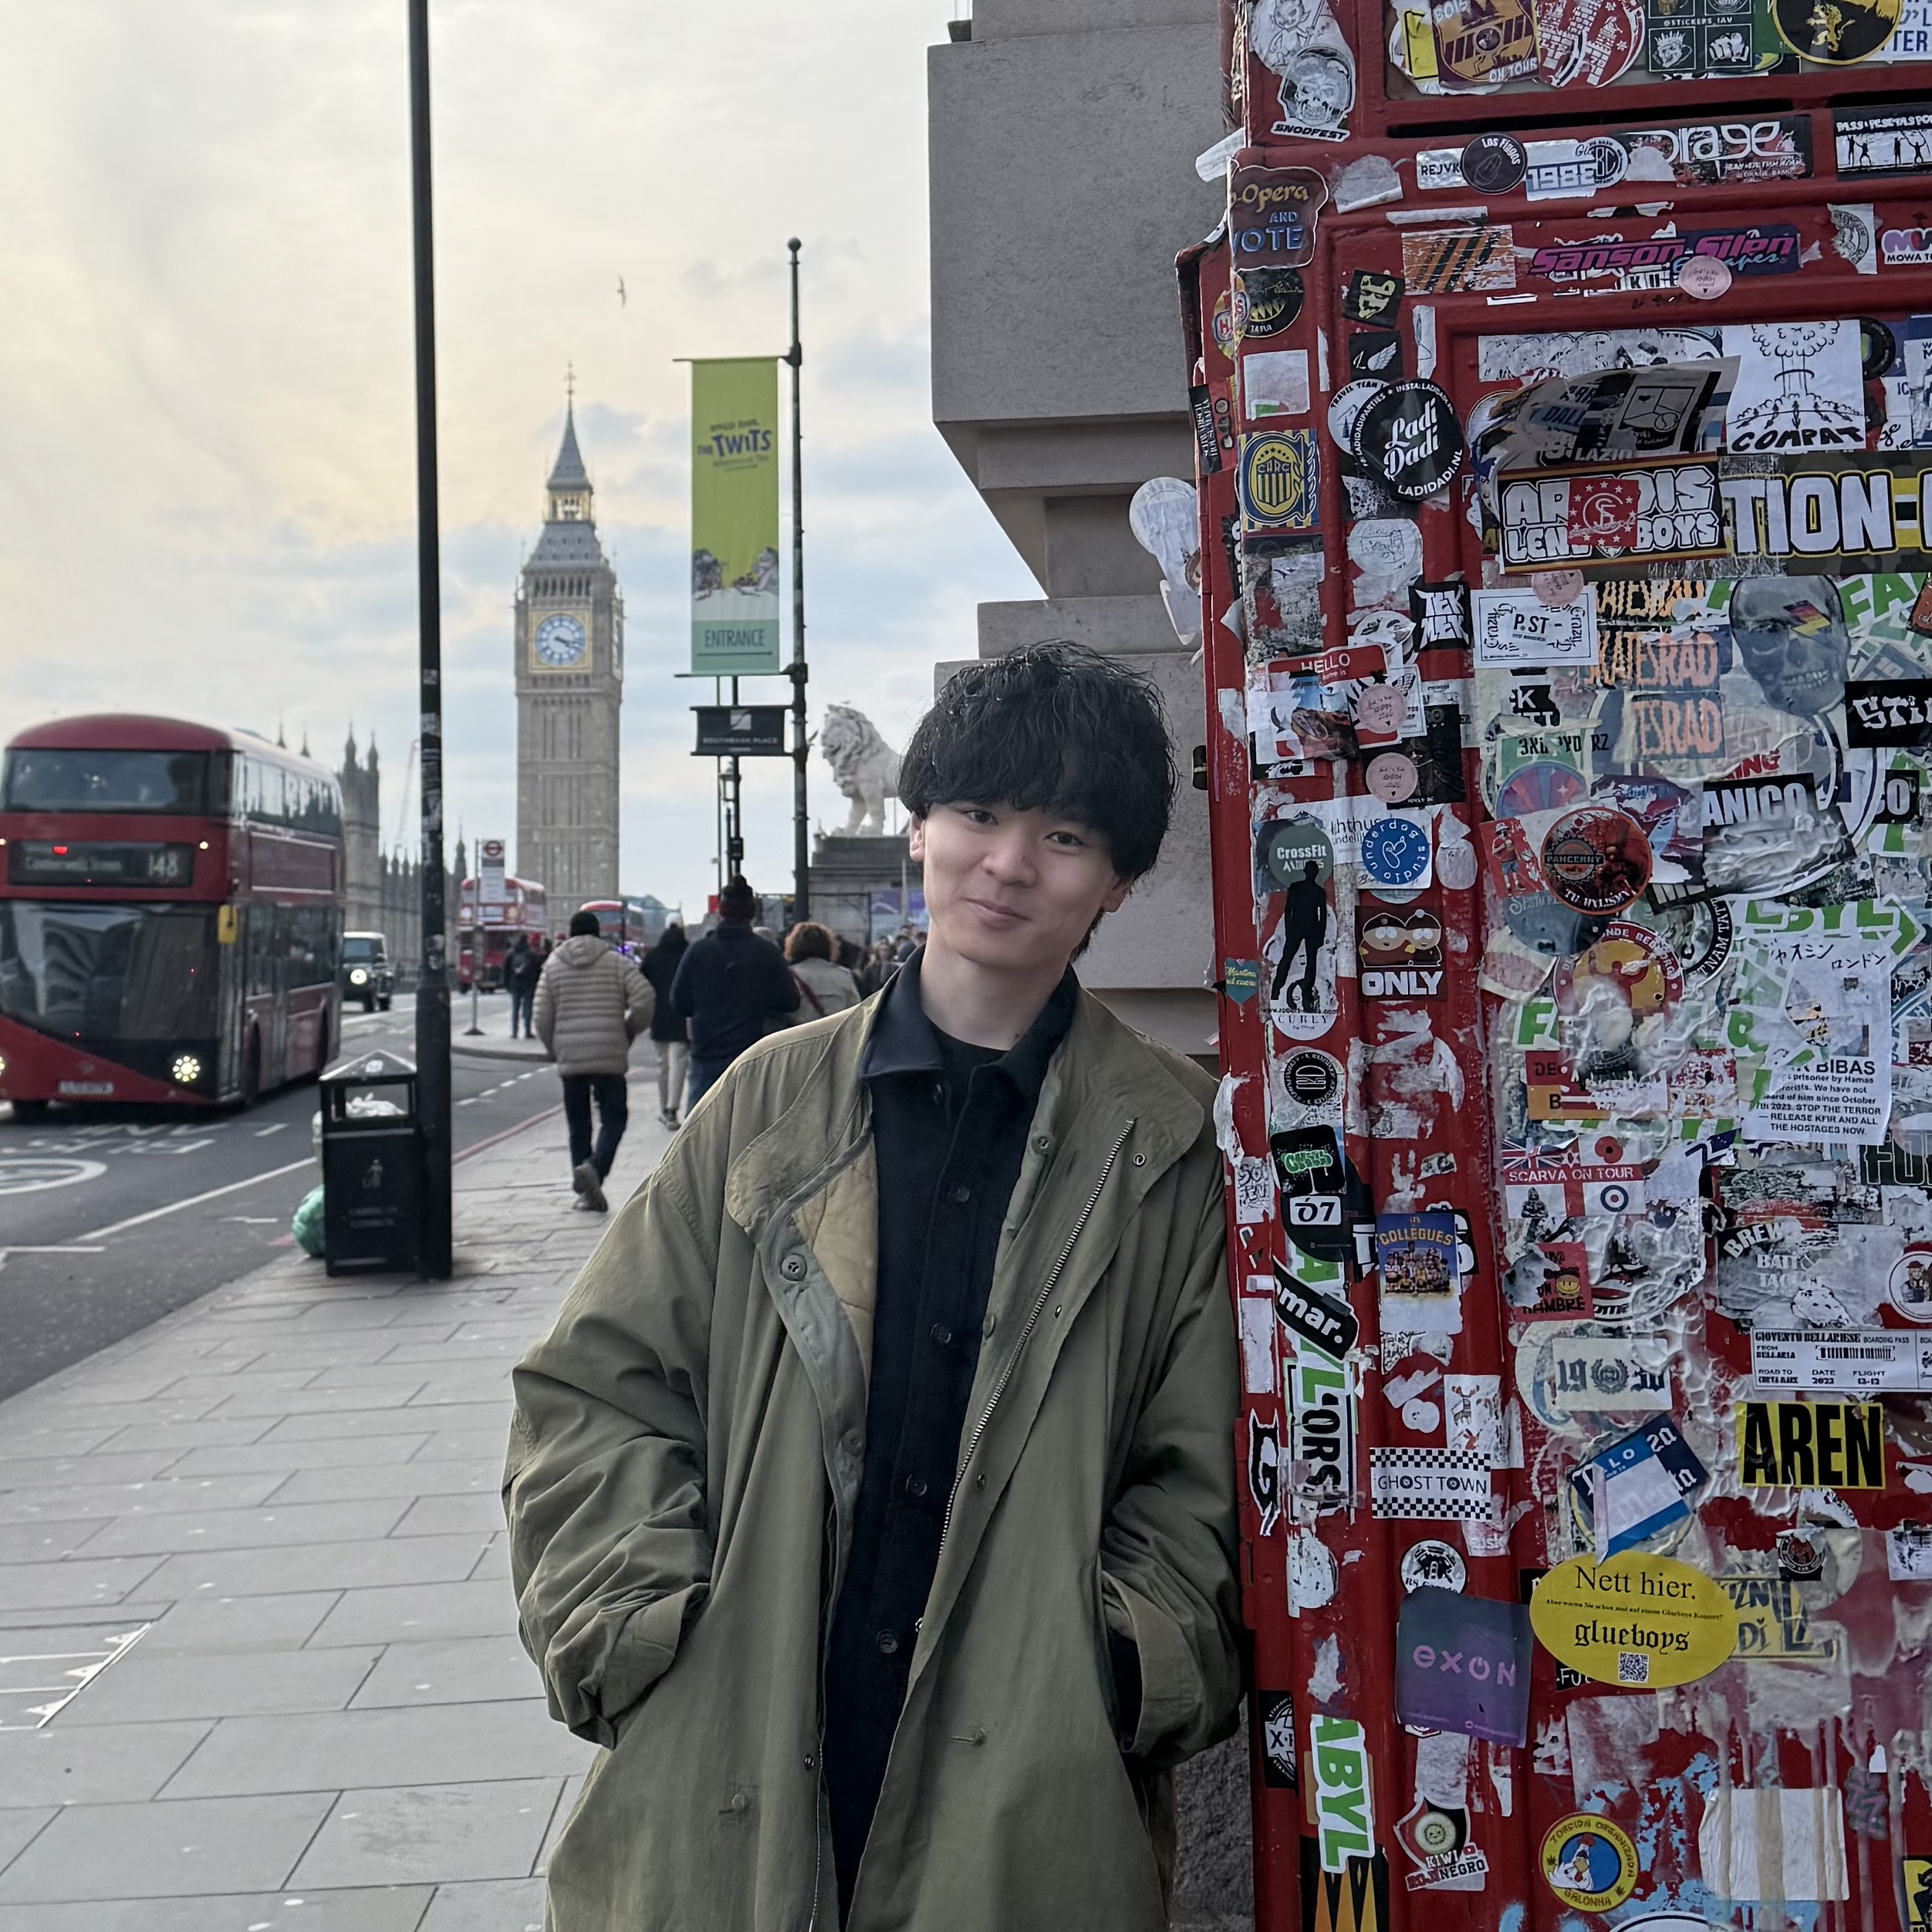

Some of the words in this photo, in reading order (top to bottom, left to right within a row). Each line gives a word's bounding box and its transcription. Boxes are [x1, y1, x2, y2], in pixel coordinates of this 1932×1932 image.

[1274, 124, 1347, 141] SNODFEST
[1269, 211, 1298, 224] AND
[1532, 239, 1685, 272] Sanson
[1887, 253, 1922, 262] MOWA
[1384, 397, 1438, 451] Ladi
[1383, 425, 1440, 482] Dadi
[1397, 449, 1464, 497] LADIDADI.NL
[1633, 511, 1718, 552] BOYS
[704, 629, 765, 648] ENTRANCE
[1302, 654, 1351, 674] HELLO
[1276, 844, 1327, 860] CrossFit
[1365, 819, 1420, 870] underdog
[148, 850, 178, 878] 148
[1383, 846, 1427, 883] studio
[1546, 855, 1602, 864] PANCERNY
[1831, 954, 1886, 970] ロンドン
[1361, 970, 1444, 997] ONLY
[1278, 1015, 1329, 1025] CURLY
[1793, 1073, 1829, 1083] prisoner
[1832, 1074, 1842, 1084] by
[1845, 1074, 1874, 1084] Hamas
[1814, 1083, 1828, 1092] We
[1829, 1084, 1850, 1093] have
[1853, 1086, 1868, 1094] not
[1787, 1093, 1796, 1101] of
[1816, 1095, 1840, 1103] since
[1842, 1096, 1876, 1105] October
[1795, 1103, 1821, 1112] STOP
[1822, 1105, 1842, 1113] THE
[1843, 1106, 1882, 1116] TERROR
[1771, 1113, 1813, 1122] RELEASE
[1839, 1115, 1859, 1124] AND
[1860, 1116, 1879, 1126] ALL
[1771, 1123, 1789, 1131] THE
[1790, 1123, 1841, 1134] HOSTAGES
[1842, 1126, 1868, 1136] NOW.
[1508, 1169, 1568, 1183] SCARVA
[1572, 1167, 1593, 1181] ON
[1596, 1167, 1634, 1180] TOUR
[1379, 1228, 1454, 1247] COLLEGUES
[1804, 1332, 1861, 1344] BELLARIESE
[1742, 1402, 1883, 1488] AREN
[1377, 1474, 1432, 1491] GHOST
[1436, 1474, 1488, 1495] TOWN
[1576, 1566, 1631, 1594] Nett
[1640, 1571, 1697, 1601] hier.
[1574, 1620, 1691, 1655] glueboys
[1426, 1849, 1461, 1869] KIWI
